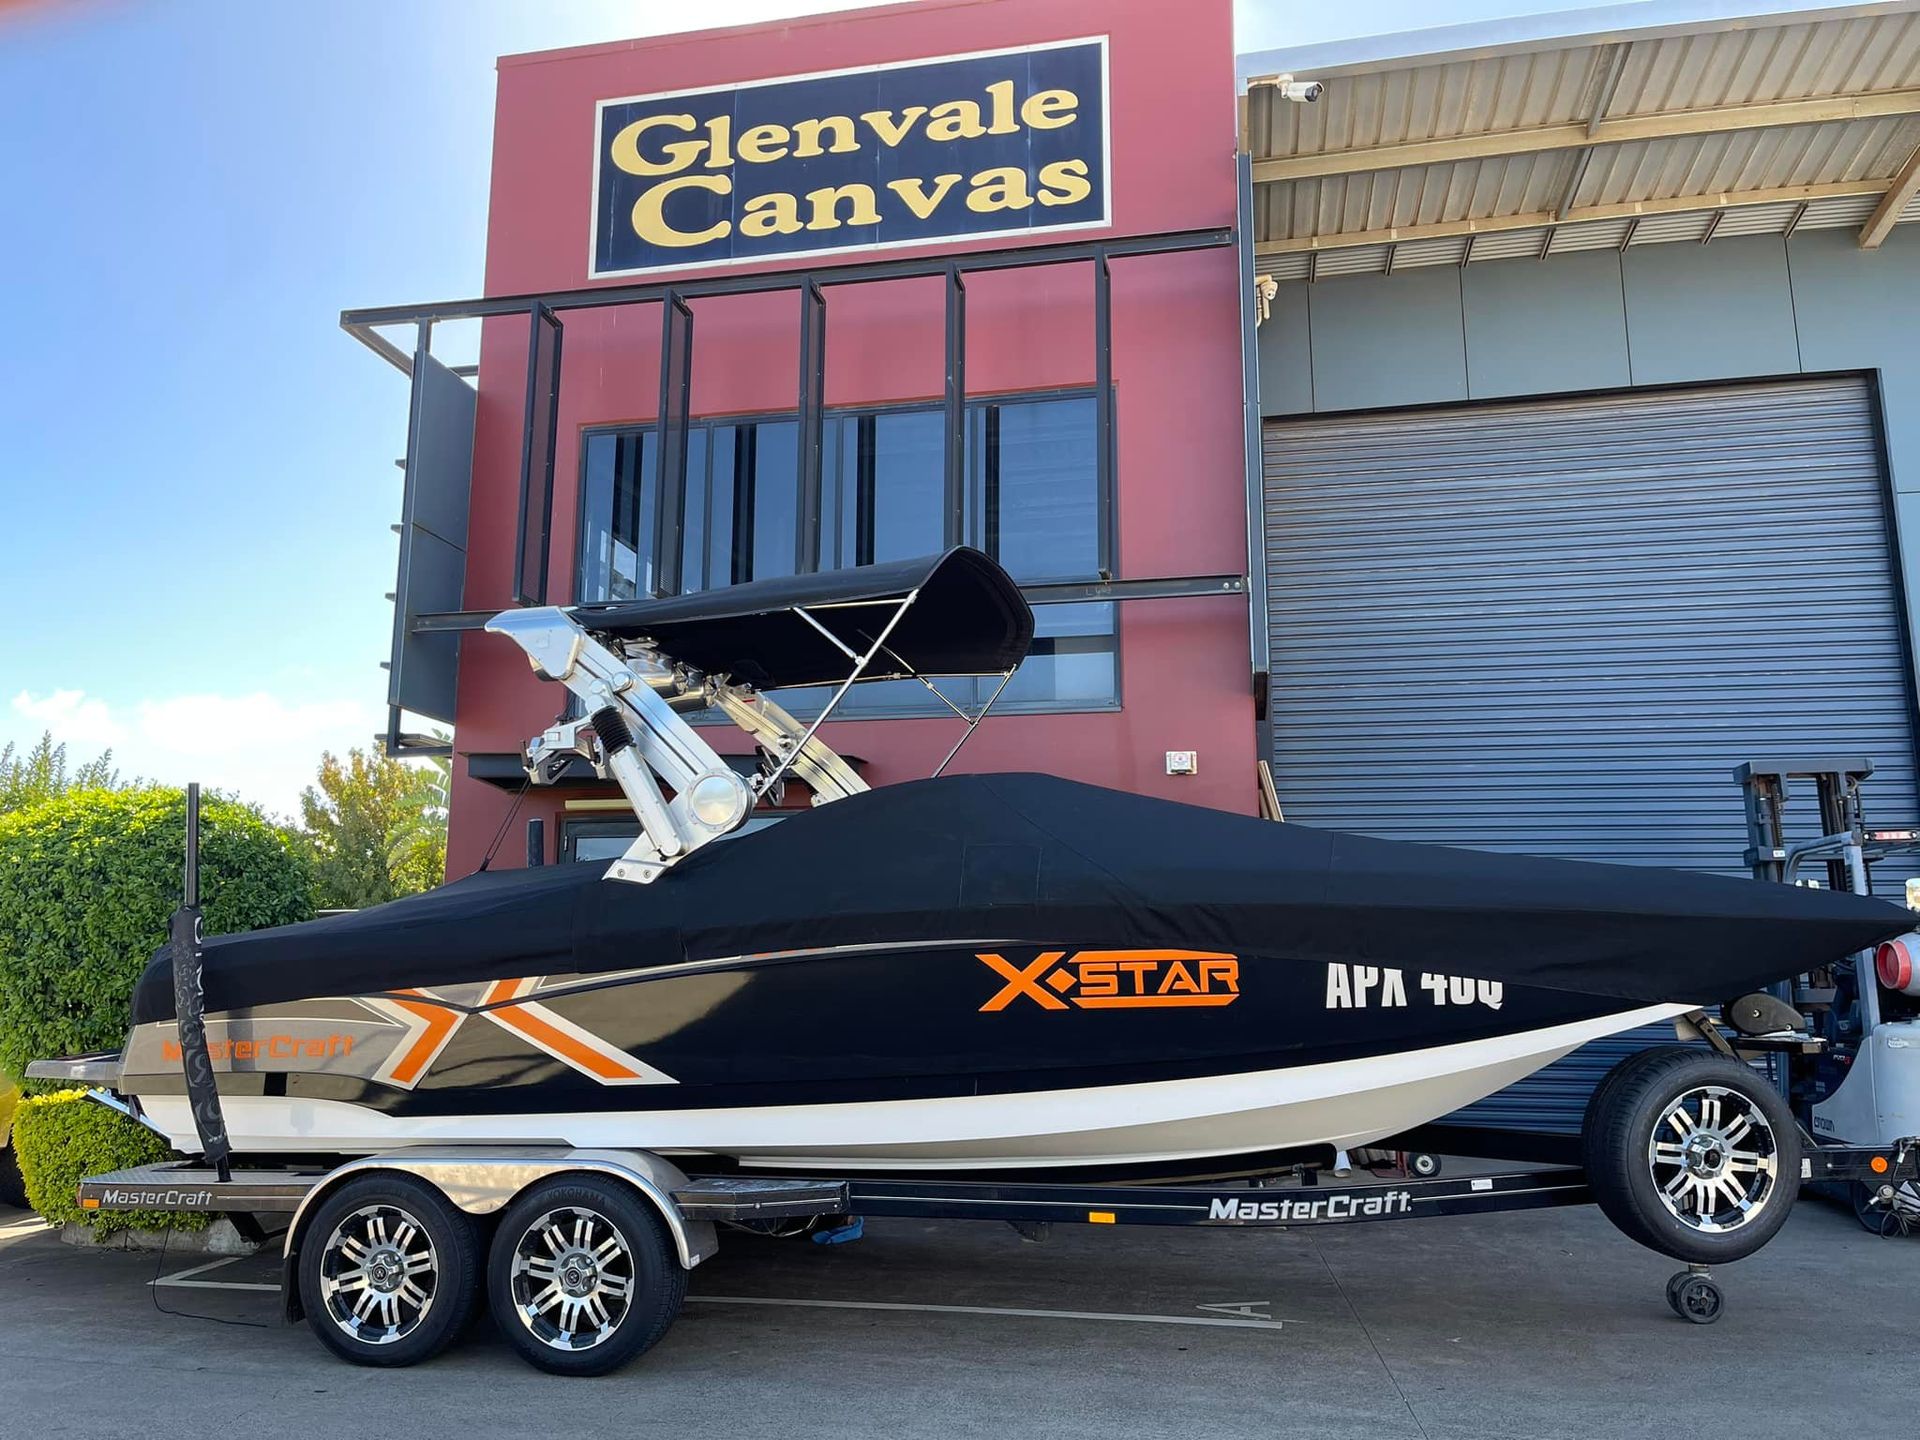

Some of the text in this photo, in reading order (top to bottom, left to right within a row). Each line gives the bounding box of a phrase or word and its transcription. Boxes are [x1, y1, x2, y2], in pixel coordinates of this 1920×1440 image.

[611, 80, 1078, 176] Glenvale
[631, 159, 1091, 247] Canvas
[161, 1033, 353, 1062] MsterCraft
[102, 1189, 213, 1205] MasterCraft
